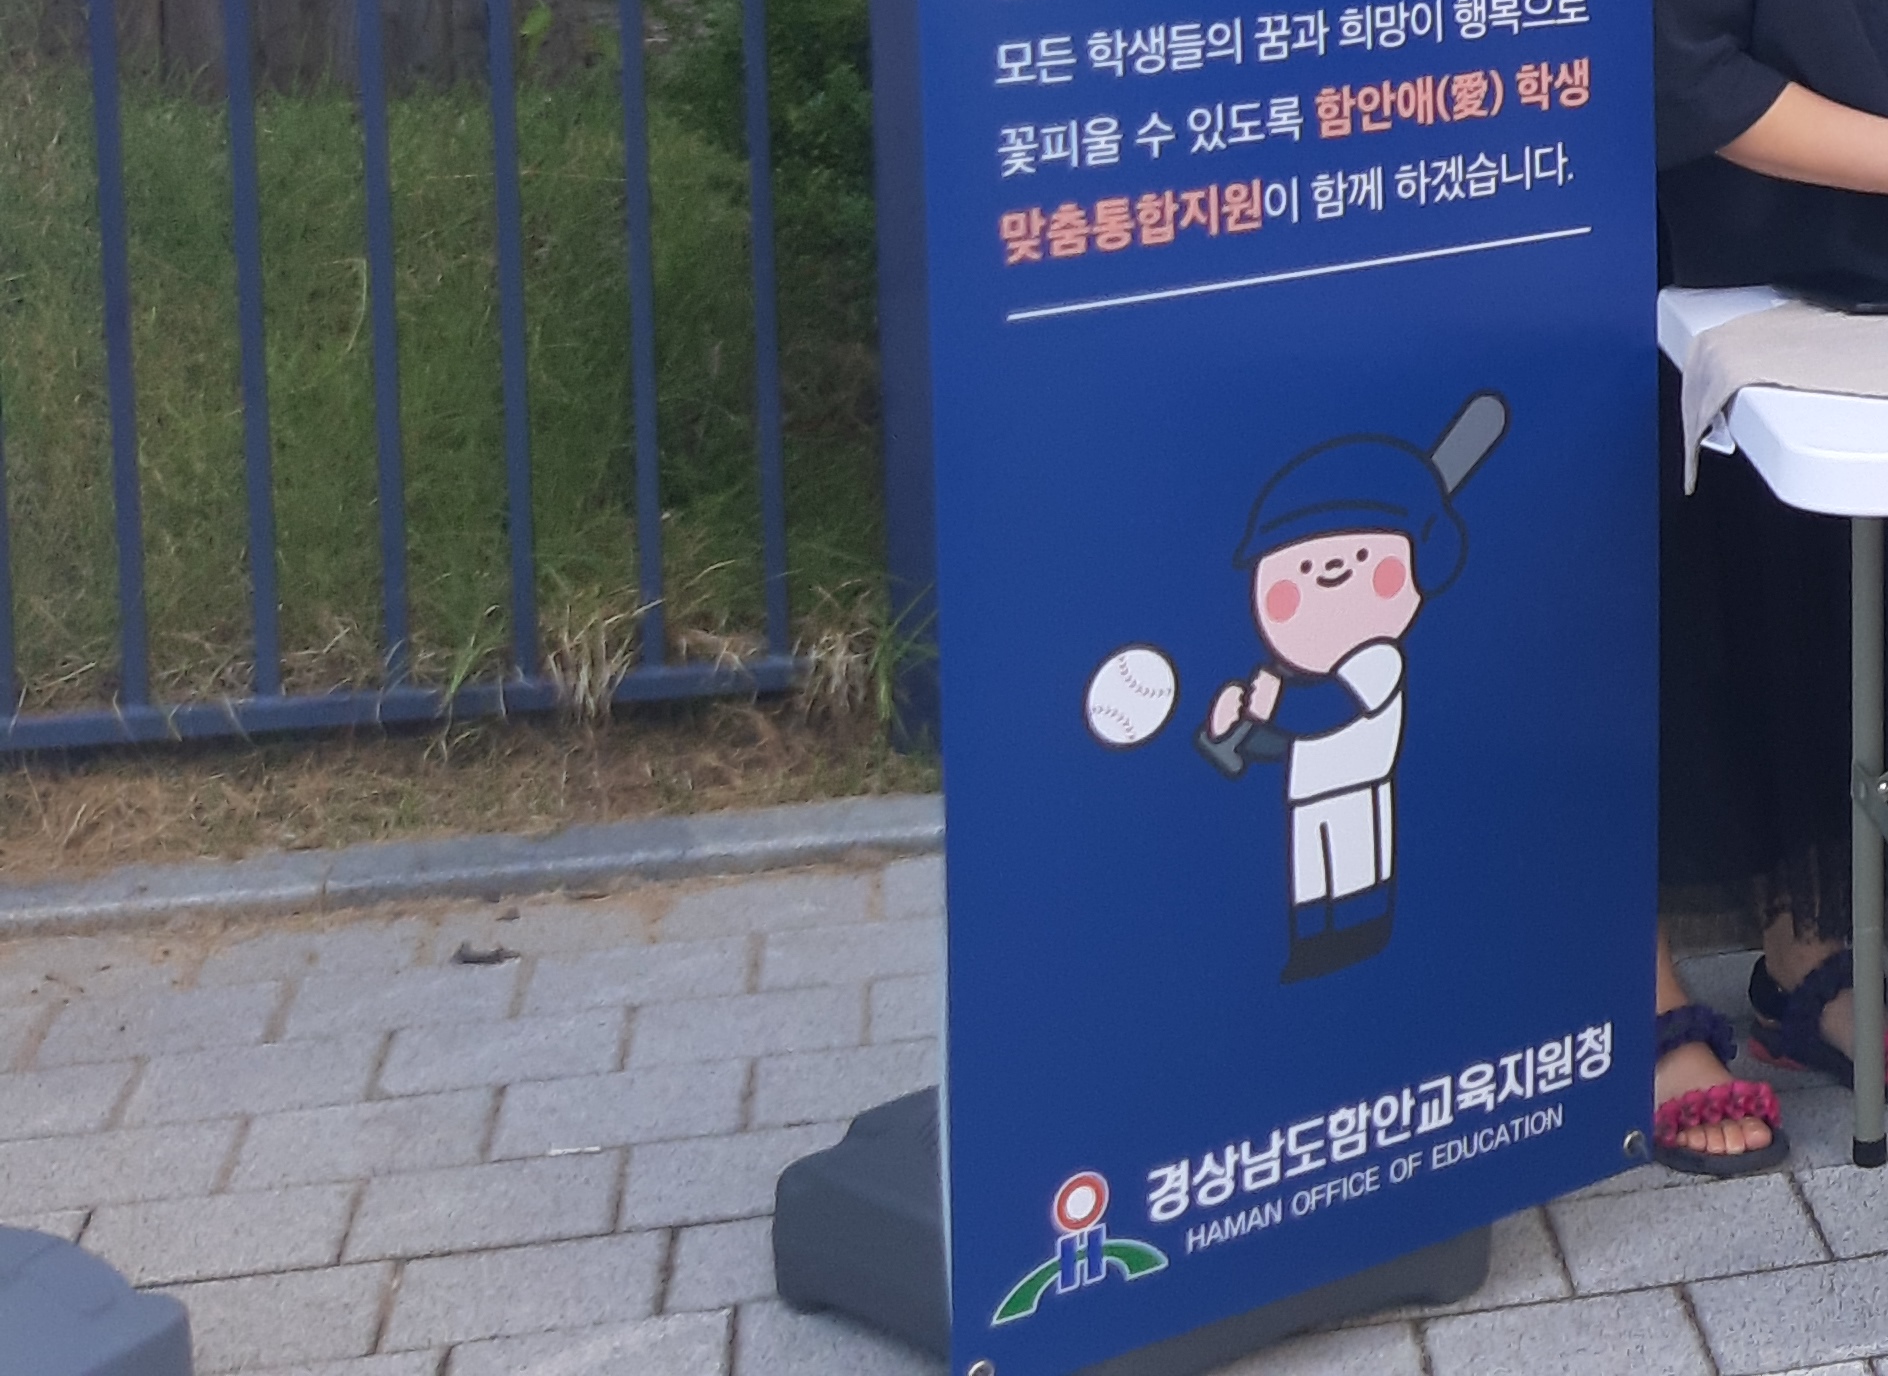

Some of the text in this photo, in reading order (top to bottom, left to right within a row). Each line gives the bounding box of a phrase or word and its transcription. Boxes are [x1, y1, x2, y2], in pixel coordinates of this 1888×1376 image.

[995, 33, 1077, 87] 모든
[1087, 16, 1244, 77] 학생들의
[1252, 7, 1329, 65] 꿈과
[997, 57, 1592, 178] 꽃피울 수 있도록 함안애(愛) 학생
[999, 140, 1576, 267] 맞춤통합지원이 함께 하겠습니다.
[1146, 1020, 1615, 1225] 경상남도함안교육지원청
[1185, 1102, 1564, 1255] HAMAN OFFICE OF EDUCATION
